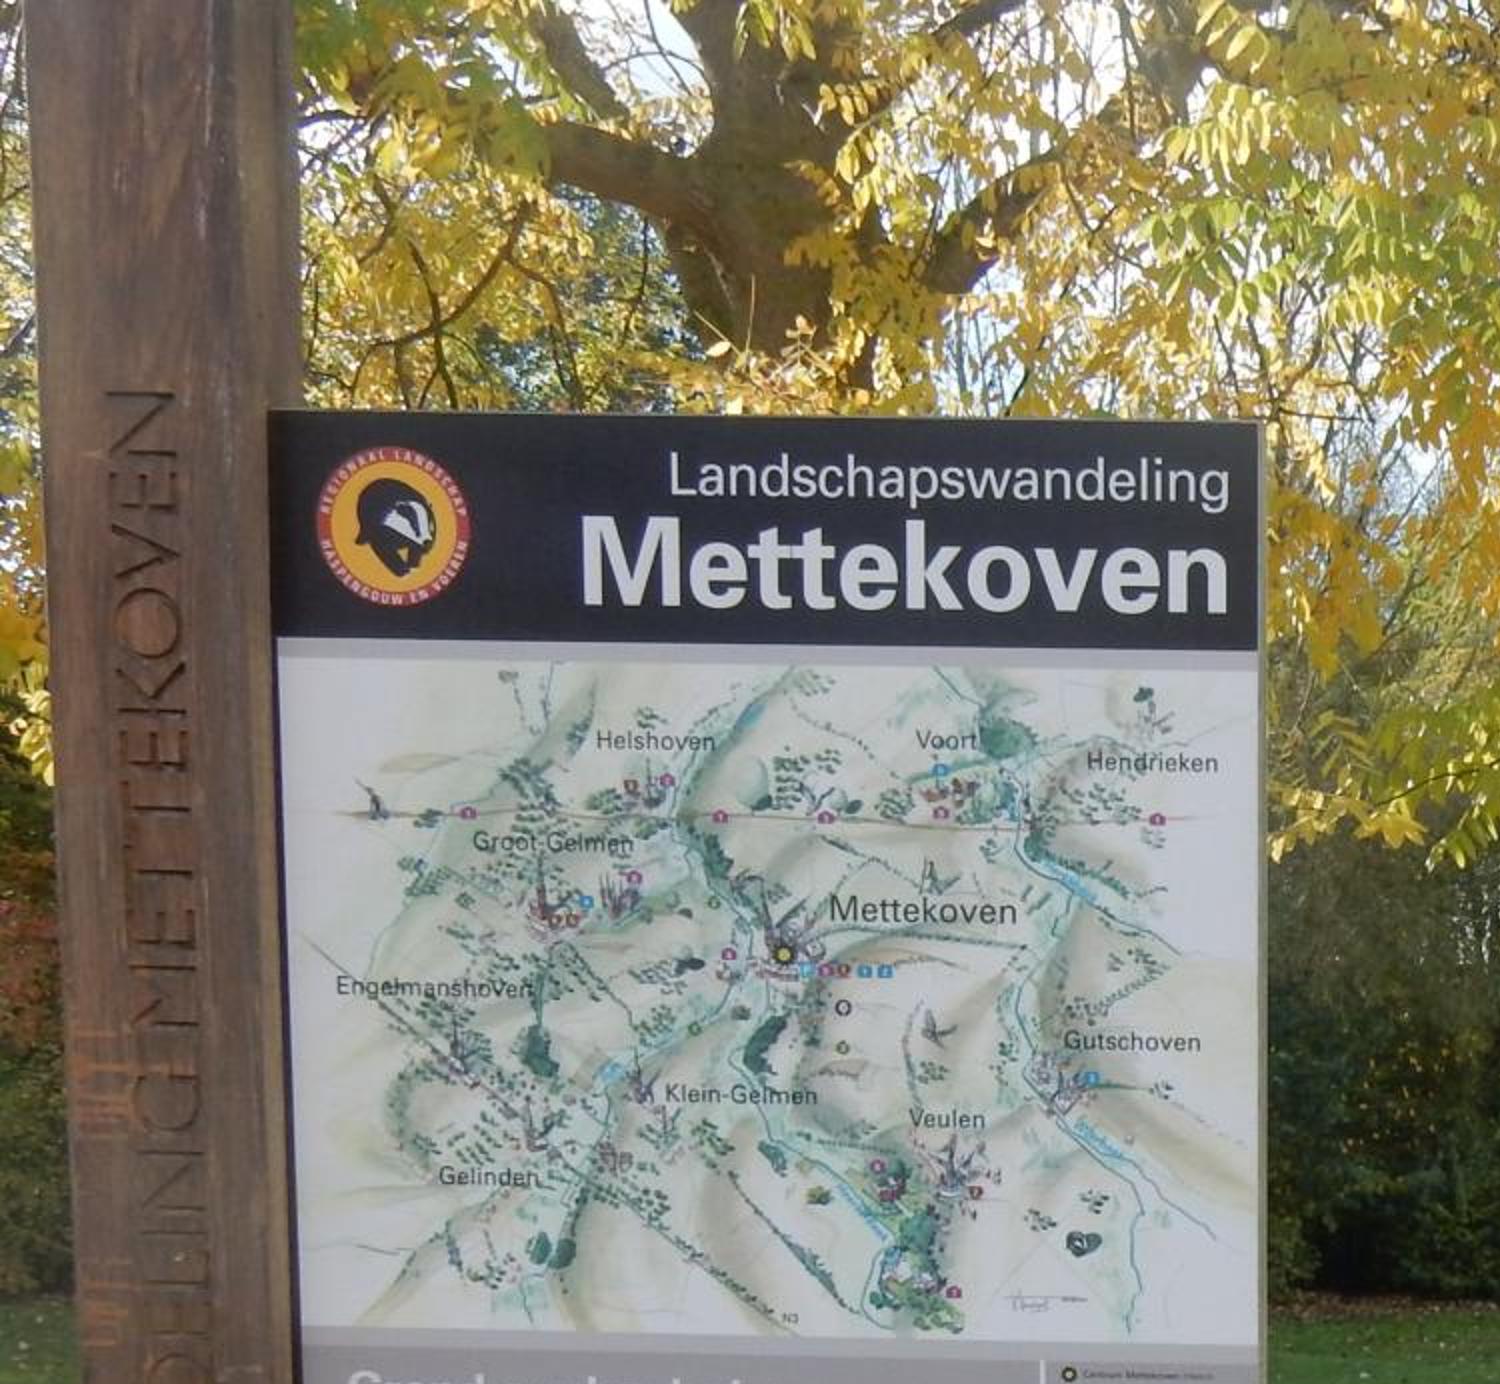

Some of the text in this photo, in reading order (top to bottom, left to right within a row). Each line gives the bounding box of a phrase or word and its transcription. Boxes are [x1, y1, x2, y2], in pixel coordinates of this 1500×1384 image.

[667, 450, 1231, 513] Landschapswandeling
[580, 515, 1228, 616] Mettekoven
[105, 388, 202, 1027] METTEKOVEN
[596, 728, 717, 755] Helshoven
[915, 728, 978, 753] Voort
[1086, 750, 1220, 776] Hendrieken
[472, 830, 634, 857] Groot-Gelmen
[828, 895, 1018, 928] Mettekoven
[335, 976, 533, 1004] Engelmanshoven
[1063, 1028, 1202, 1054] Gutschoven
[663, 1082, 818, 1109] Klein-Gelmen
[908, 1108, 986, 1131] Veulen
[437, 1163, 540, 1188] Gelinden
